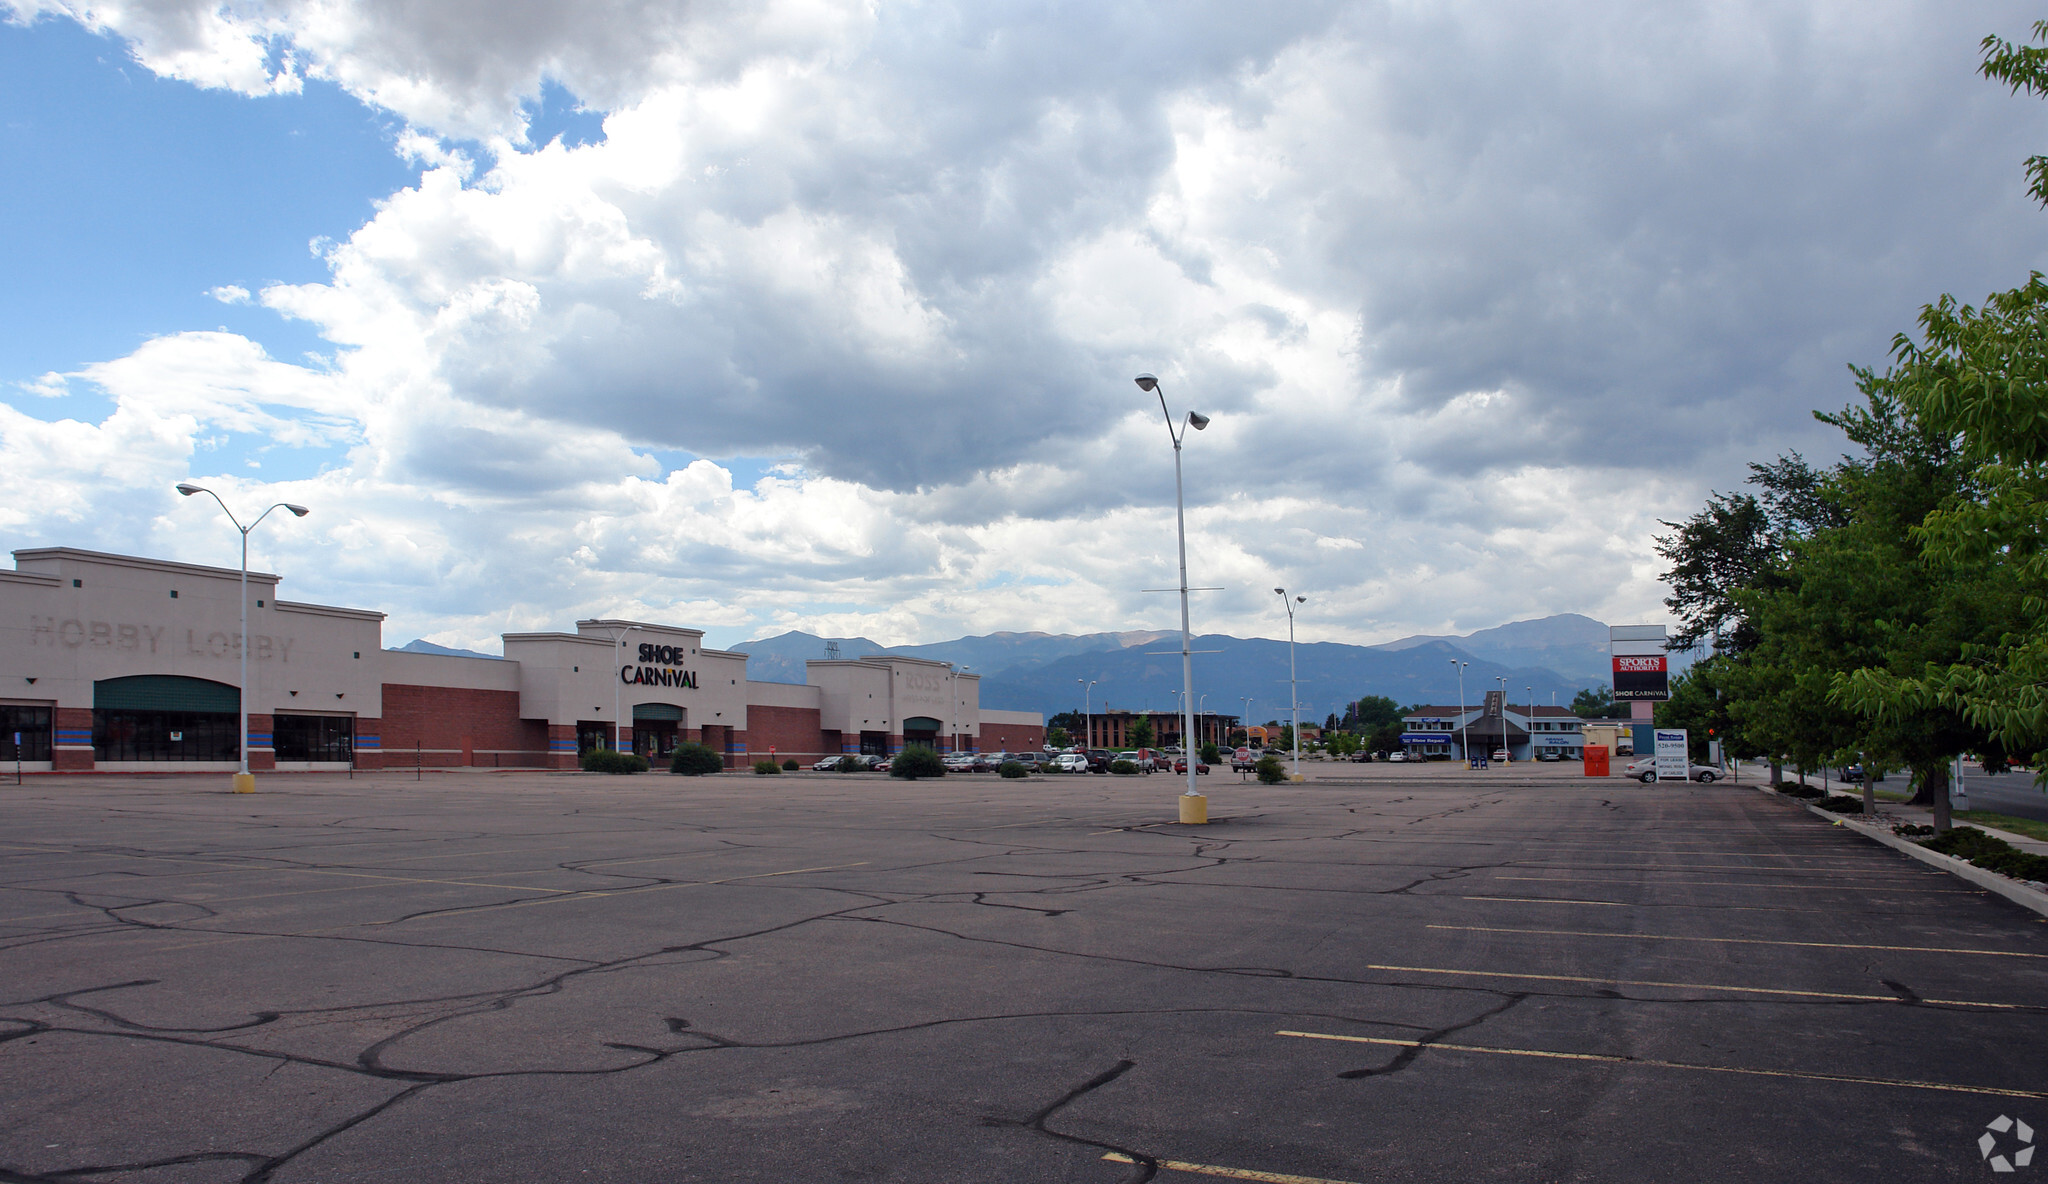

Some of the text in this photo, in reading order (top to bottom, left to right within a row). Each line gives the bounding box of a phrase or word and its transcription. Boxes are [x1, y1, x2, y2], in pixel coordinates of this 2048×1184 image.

[30, 614, 294, 663] HOBBY LOBBY
[638, 643, 684, 666] SHOE
[1619, 658, 1660, 666] SPORTS
[905, 671, 940, 692] ROSS
